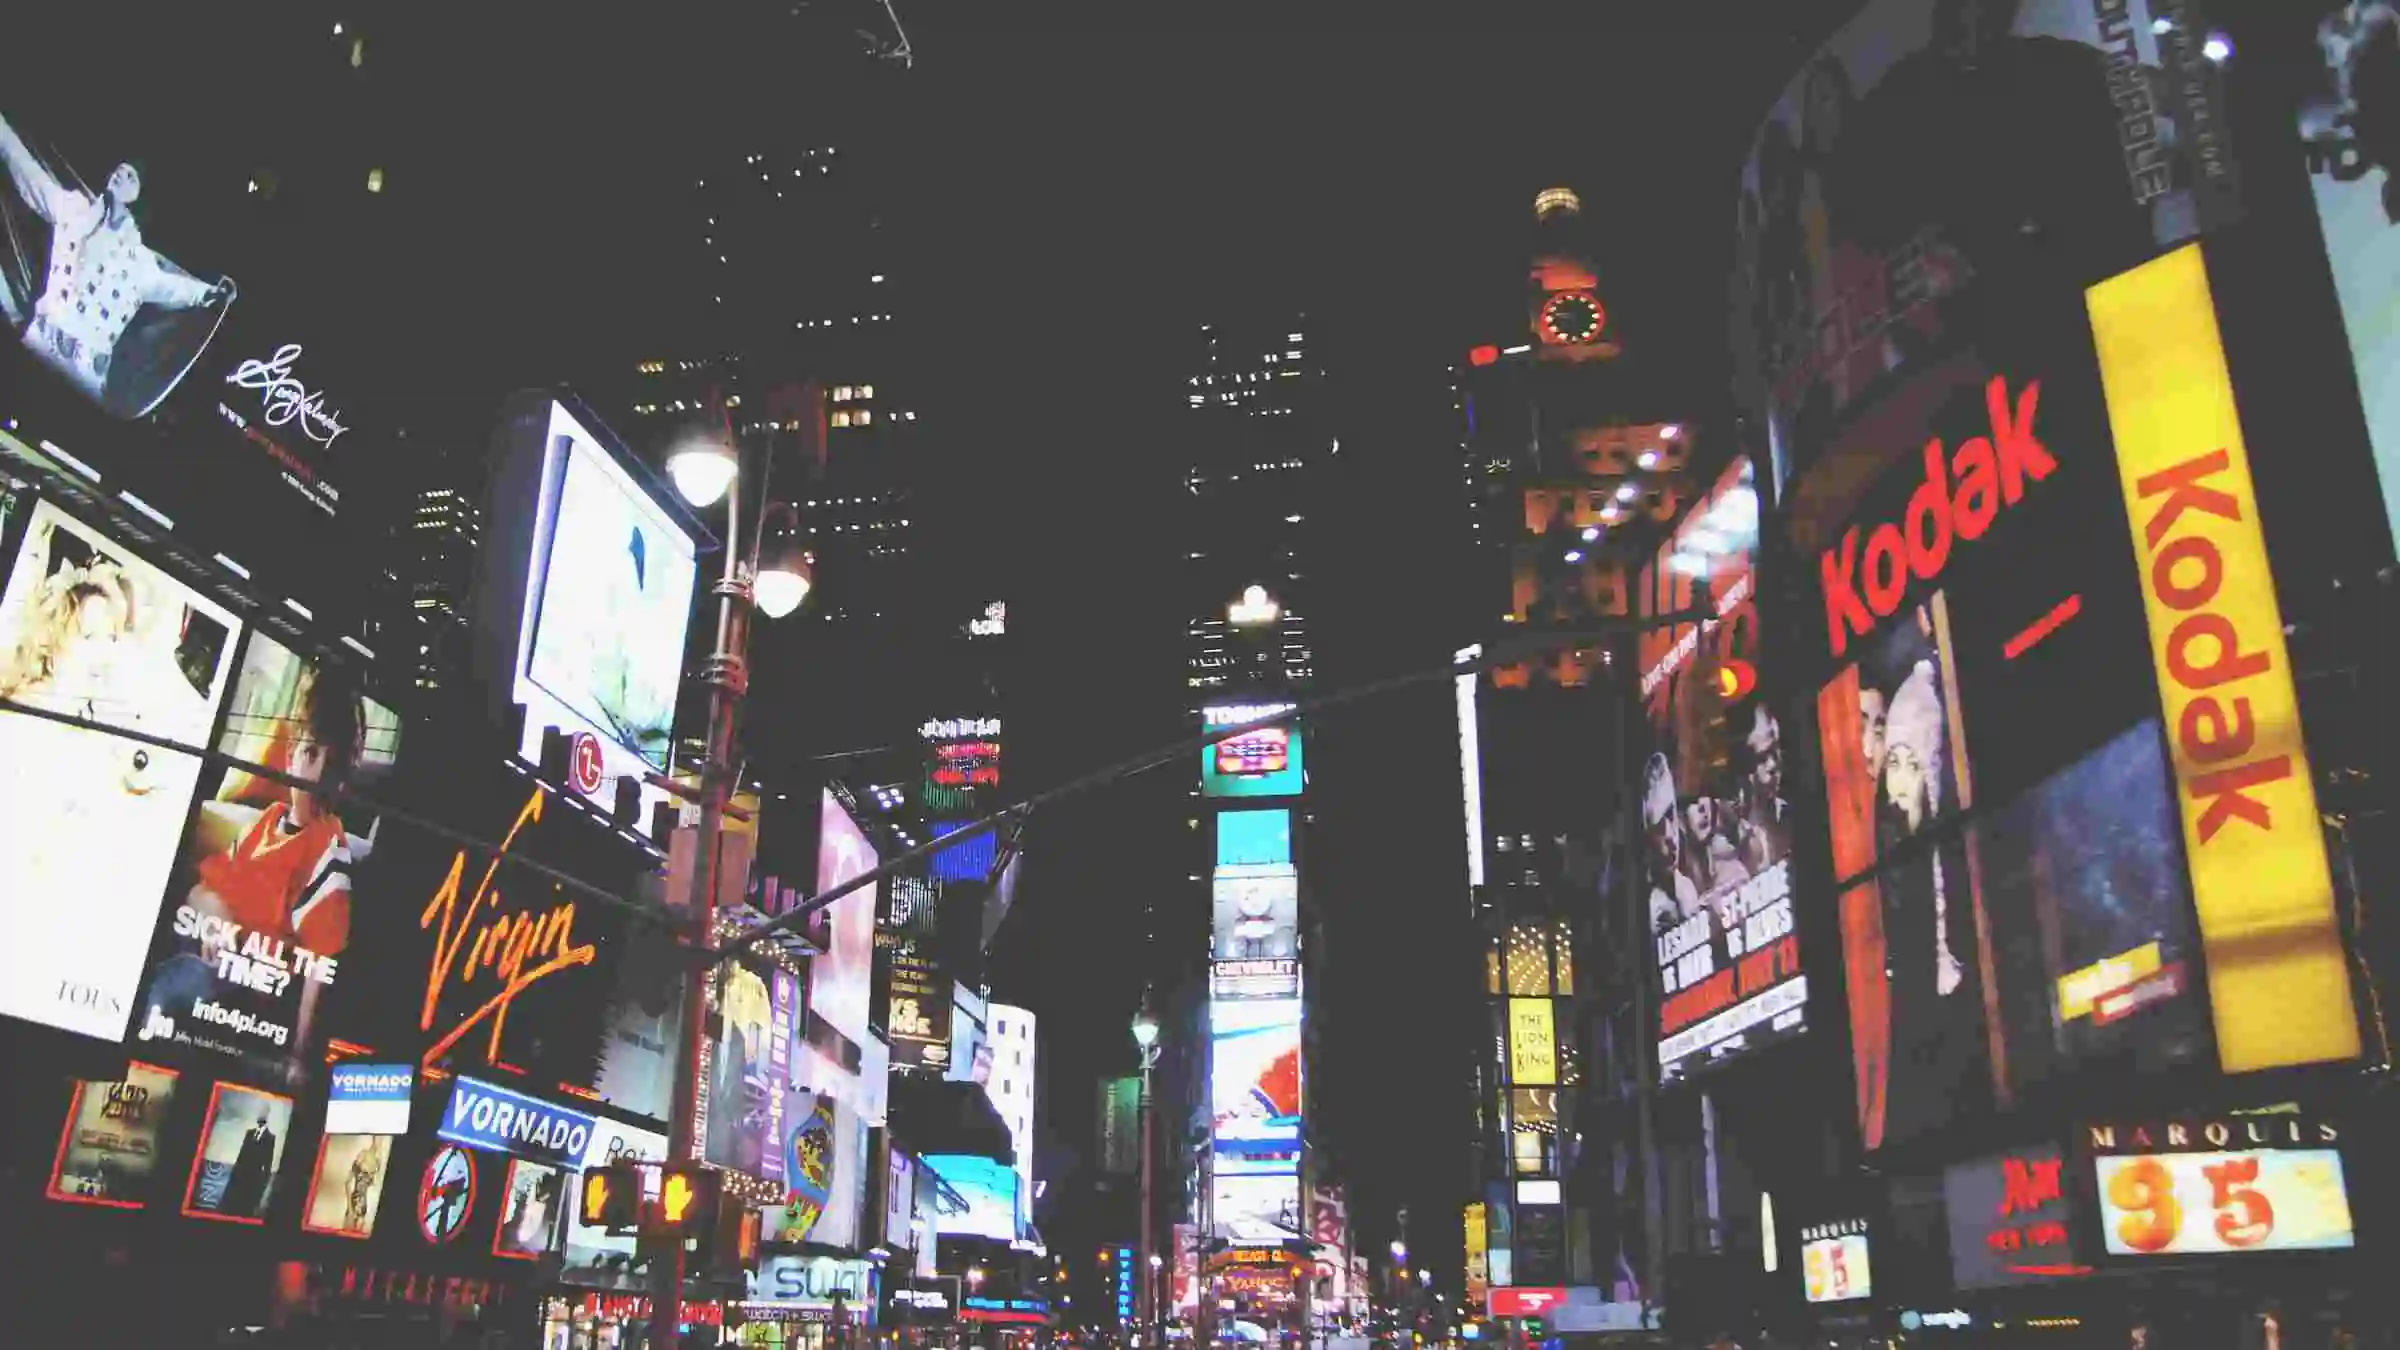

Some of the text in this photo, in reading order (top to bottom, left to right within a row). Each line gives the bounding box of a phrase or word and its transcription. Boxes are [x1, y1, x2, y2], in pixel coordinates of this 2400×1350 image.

[1821, 373, 2059, 658] Kodak
[2136, 447, 2293, 847] Kodak
[173, 904, 339, 985] SICK ALL THE
[420, 786, 596, 1079] Virgin
[217, 948, 291, 998] TIME?
[1516, 1031, 1548, 1048] LION
[1520, 1014, 1542, 1026] THE
[332, 1071, 413, 1089] VORNADO
[1516, 1052, 1551, 1073] KING
[453, 1087, 588, 1157] VORNADO
[2090, 1121, 2338, 1148] MARQUIS
